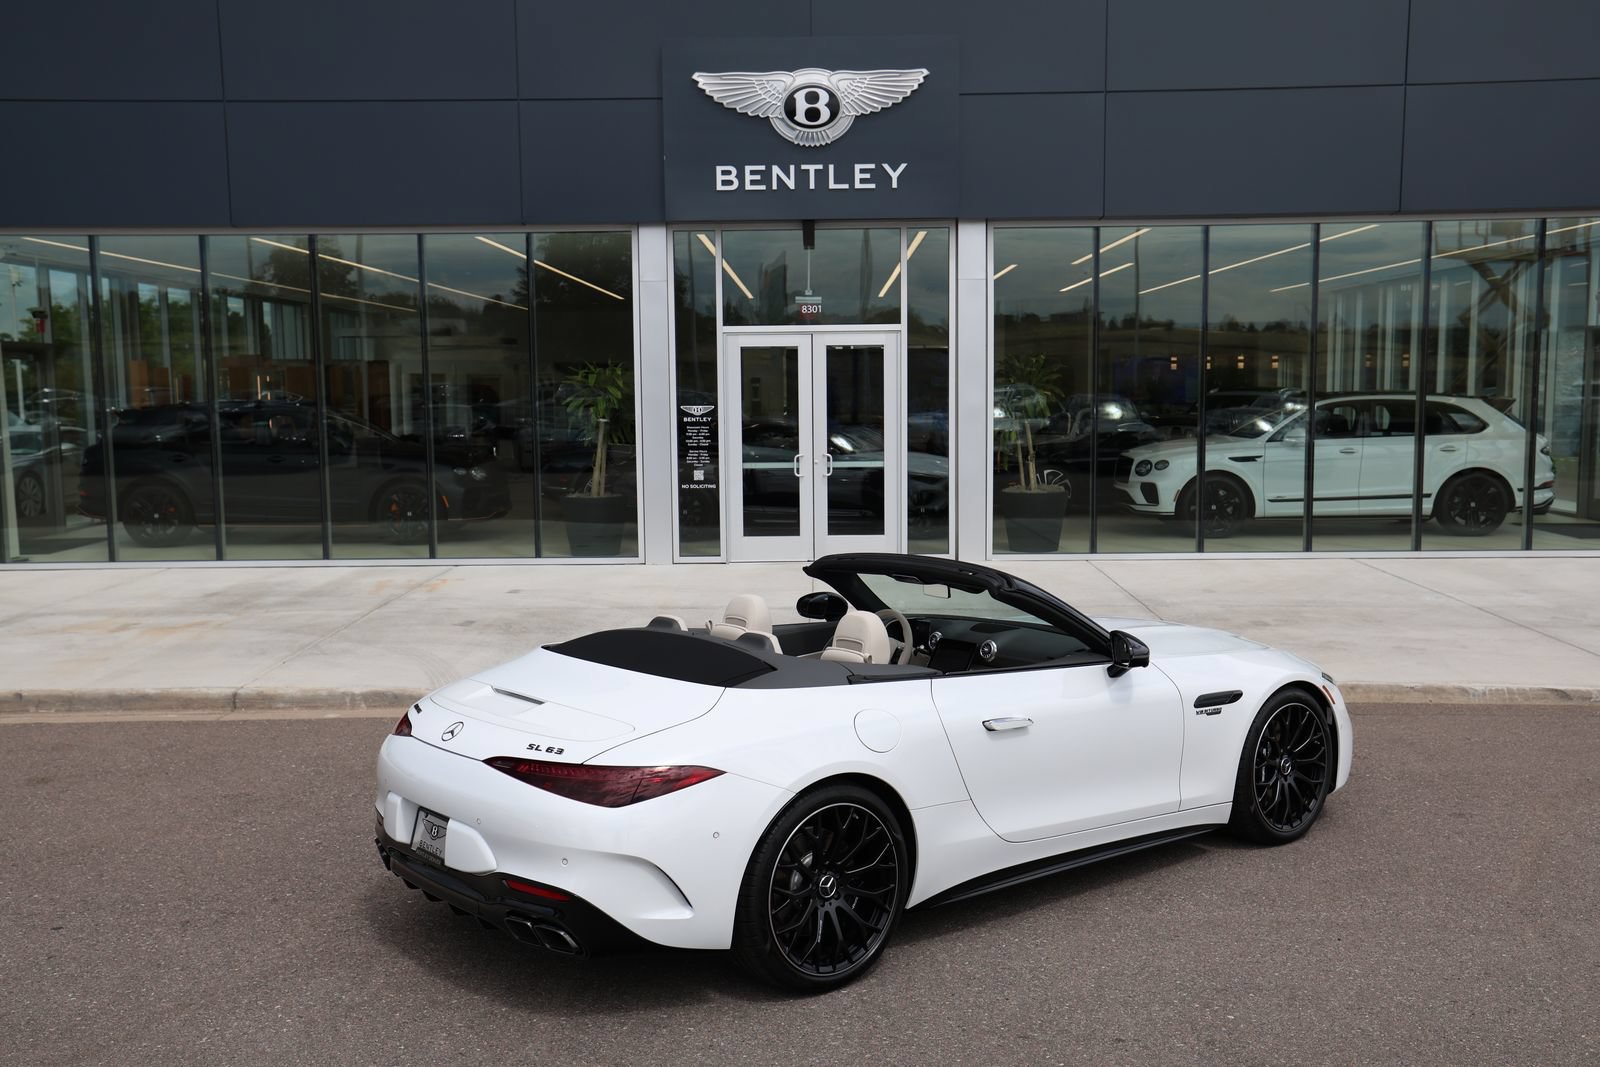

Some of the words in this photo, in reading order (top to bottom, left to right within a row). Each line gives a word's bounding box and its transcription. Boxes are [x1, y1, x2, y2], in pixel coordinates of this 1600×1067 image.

[793, 87, 831, 126] B
[715, 162, 908, 191] BENTLEY
[801, 304, 822, 314] 8301
[526, 743, 543, 752] SL
[545, 746, 565, 755] 63
